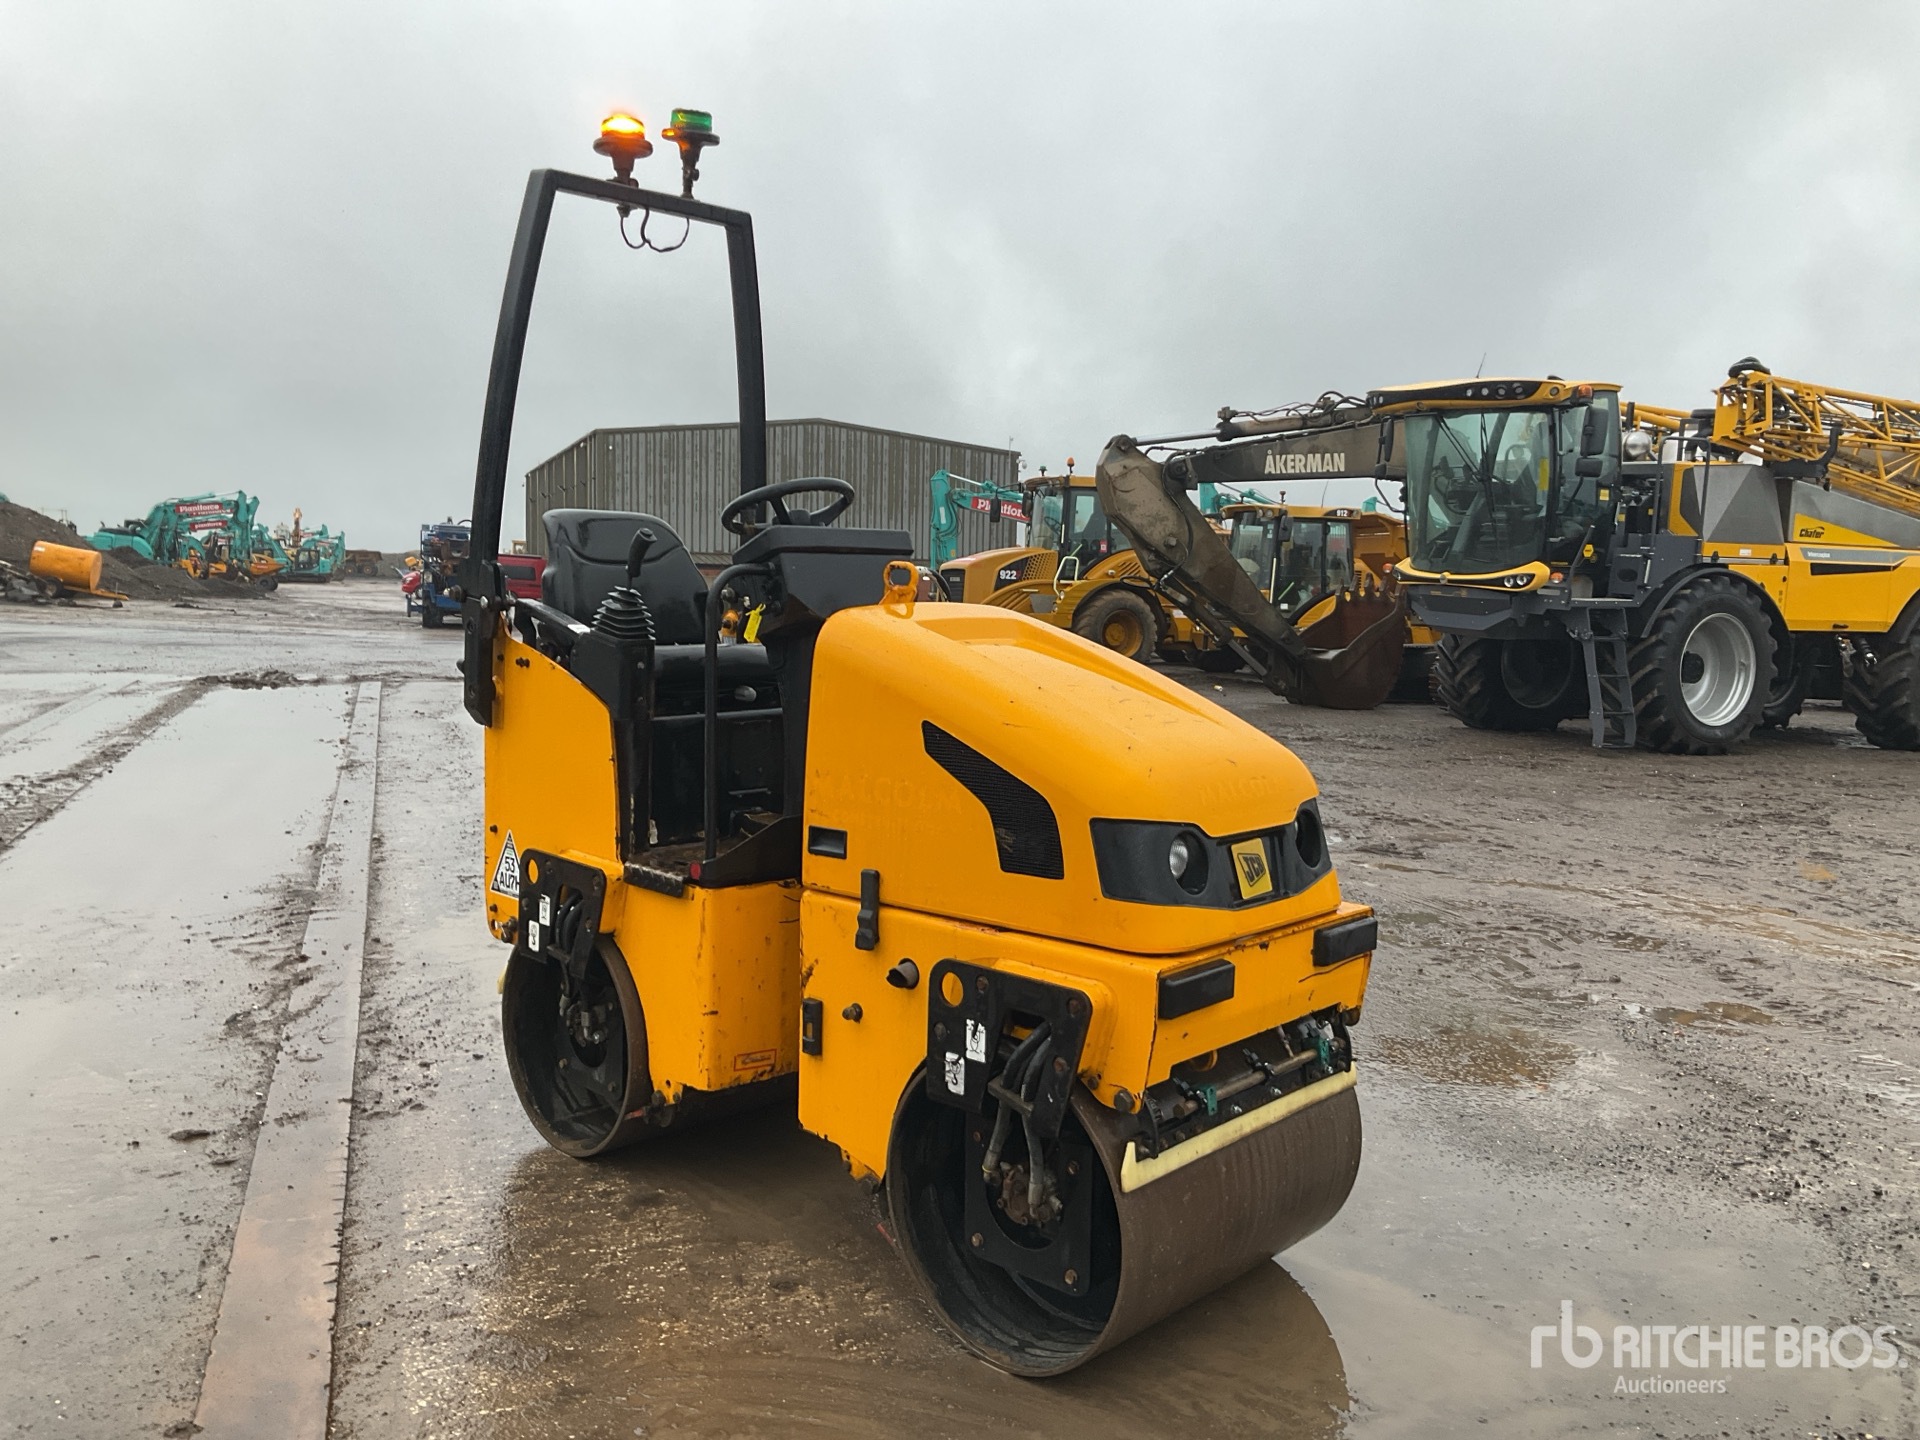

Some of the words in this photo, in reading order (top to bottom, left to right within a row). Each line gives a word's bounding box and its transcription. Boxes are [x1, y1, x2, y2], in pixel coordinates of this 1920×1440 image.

[1264, 449, 1345, 474] ÅKERMAN
[1000, 570, 1017, 580] 922
[504, 855, 515, 873] 53
[1240, 854, 1266, 884] JCB
